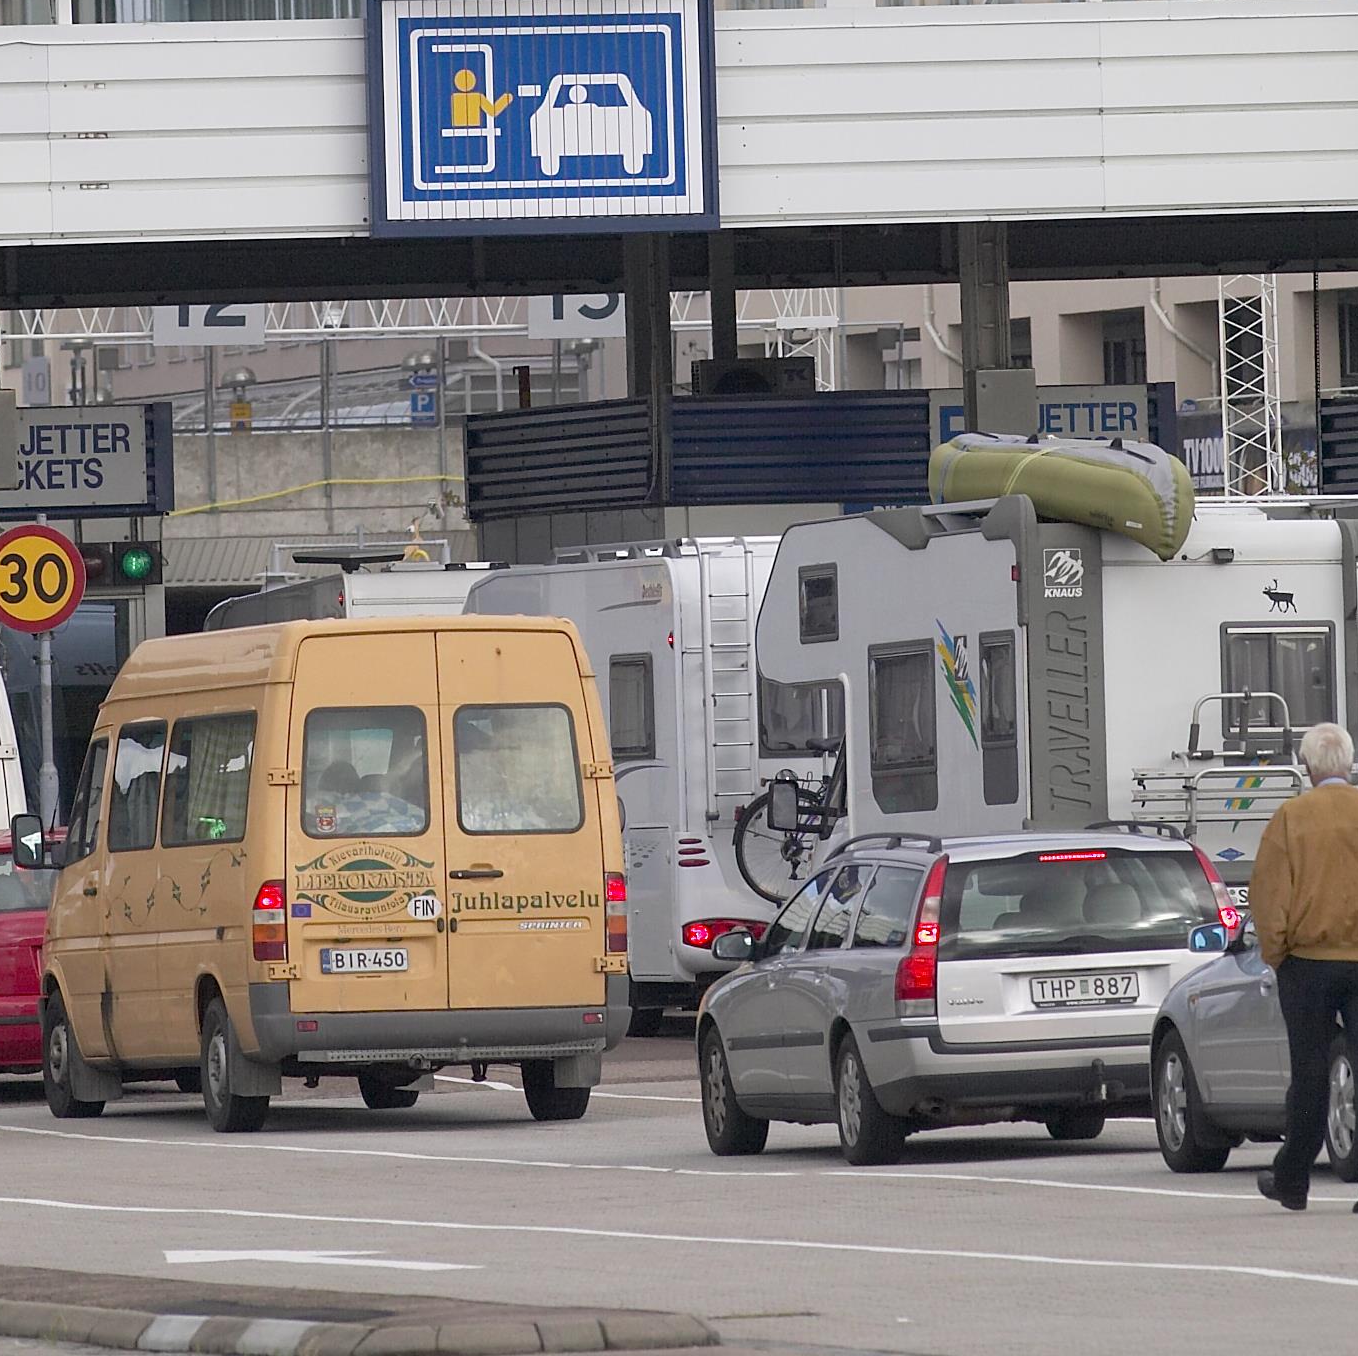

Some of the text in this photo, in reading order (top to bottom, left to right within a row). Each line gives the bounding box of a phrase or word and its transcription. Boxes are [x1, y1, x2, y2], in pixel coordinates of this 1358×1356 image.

[17, 423, 130, 456] JETTER
[0, 553, 69, 604] 30
[1044, 587, 1083, 598] KNAUS
[1045, 610, 1092, 811] TRAVELLER
[414, 899, 435, 917] FIN
[452, 890, 600, 913] Juhlapalvelu
[335, 952, 404, 968] BIR-450
[1037, 976, 1132, 999] THP 887
